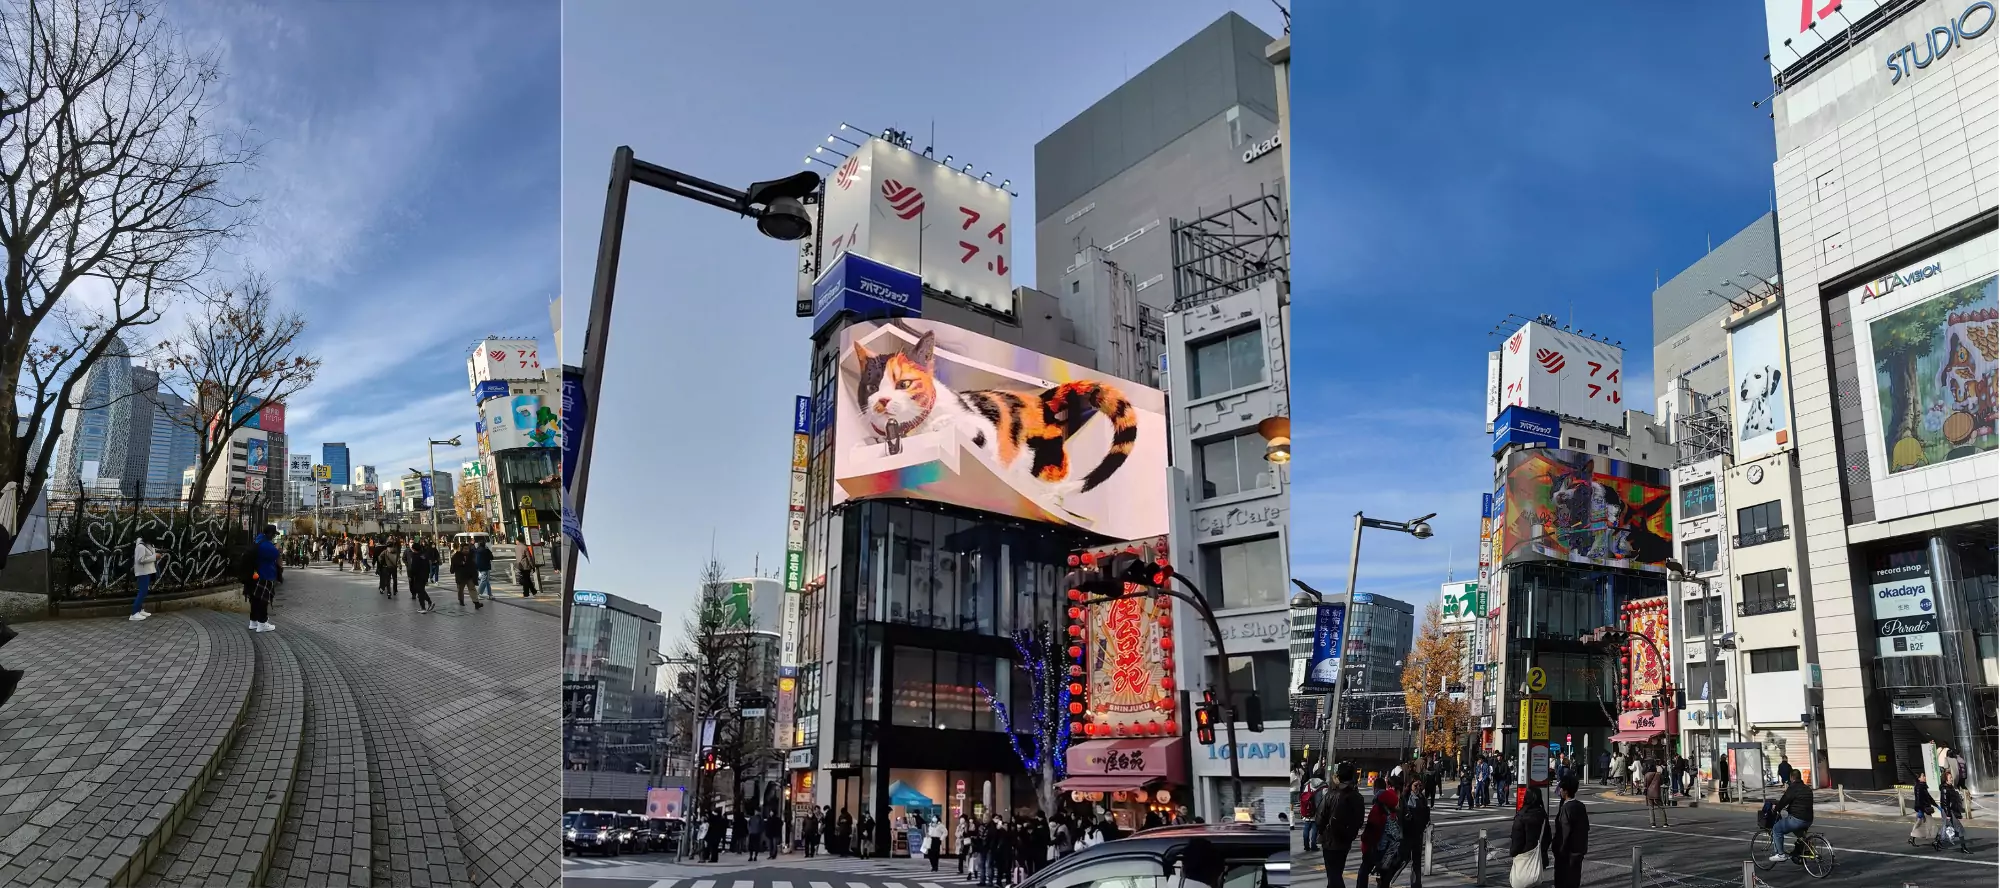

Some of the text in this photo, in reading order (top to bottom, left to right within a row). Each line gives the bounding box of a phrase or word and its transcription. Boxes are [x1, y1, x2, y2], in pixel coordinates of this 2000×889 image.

[1887, 1, 1996, 86] STUDIO
[959, 206, 1006, 244] アイ
[959, 241, 1009, 276] フル
[860, 280, 909, 303] アパマンショップ
[1587, 360, 1619, 383] アイ
[1587, 383, 1621, 404] フル
[290, 460, 310, 470] 楽待
[1877, 564, 1922, 576] record shop
[576, 593, 604, 602] welcia
[1879, 585, 1926, 599] okadaya
[1241, 620, 1290, 640] Shop
[1881, 619, 1930, 636] Parade
[1910, 643, 1924, 651] B2F
[1532, 670, 1543, 687] 2
[1109, 703, 1150, 712] SHINJUKU
